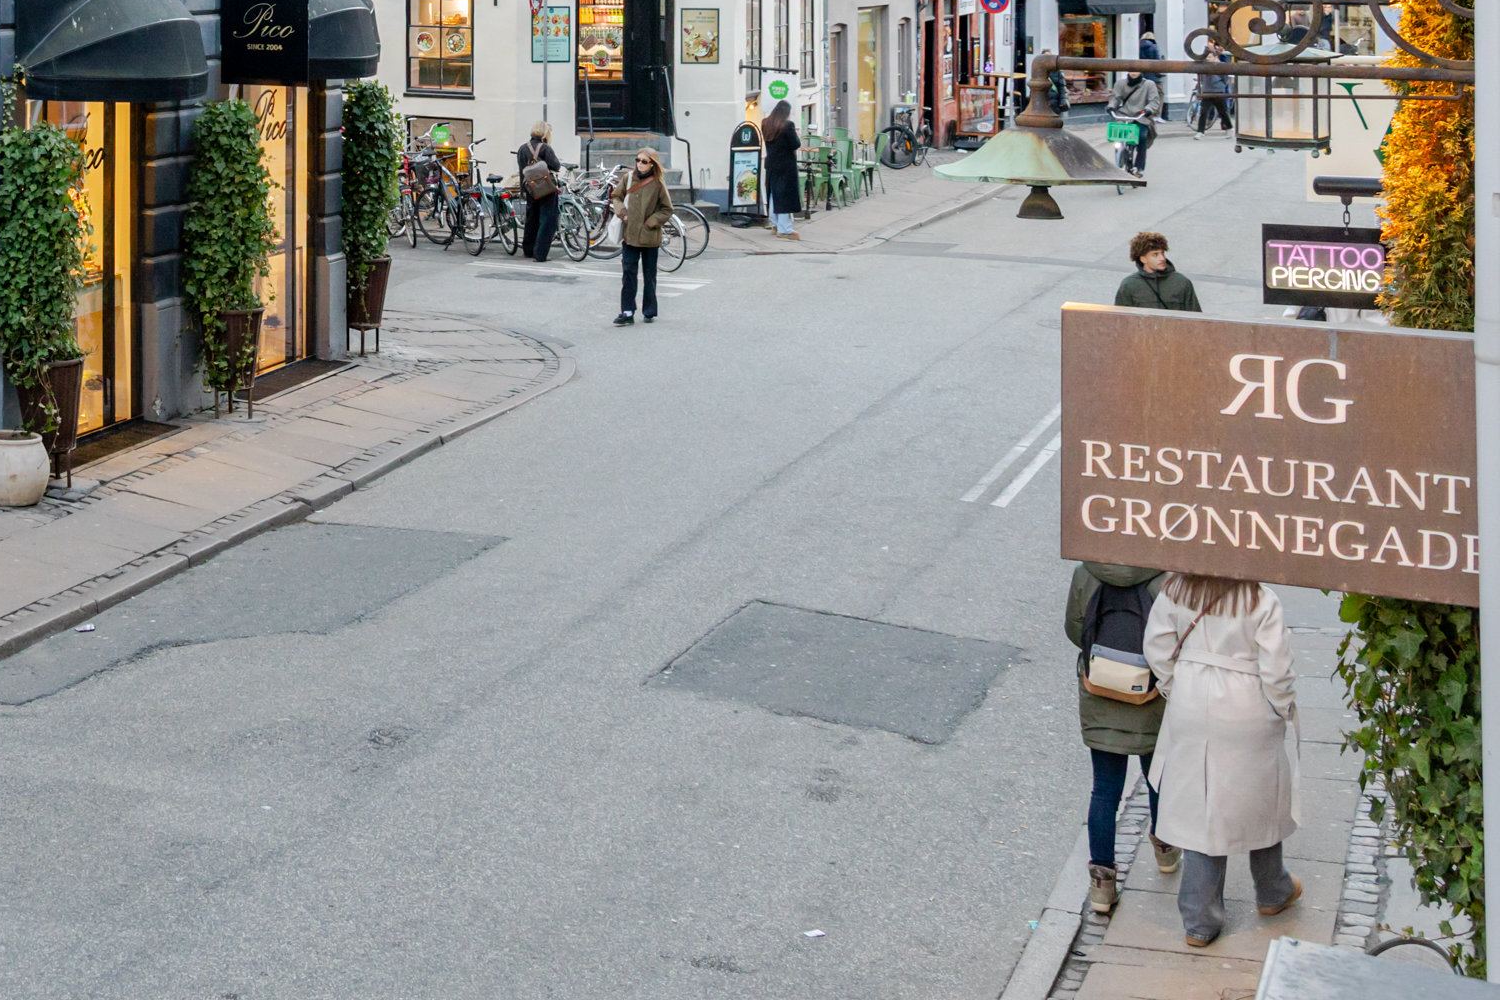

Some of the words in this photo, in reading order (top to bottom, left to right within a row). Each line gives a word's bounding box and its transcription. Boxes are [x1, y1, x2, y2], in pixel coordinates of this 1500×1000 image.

[232, 2, 296, 39] Pico
[1268, 243, 1382, 270] TATTOO
[1271, 265, 1382, 292] PIERCING
[1080, 439, 1471, 515] RESTAURANT
